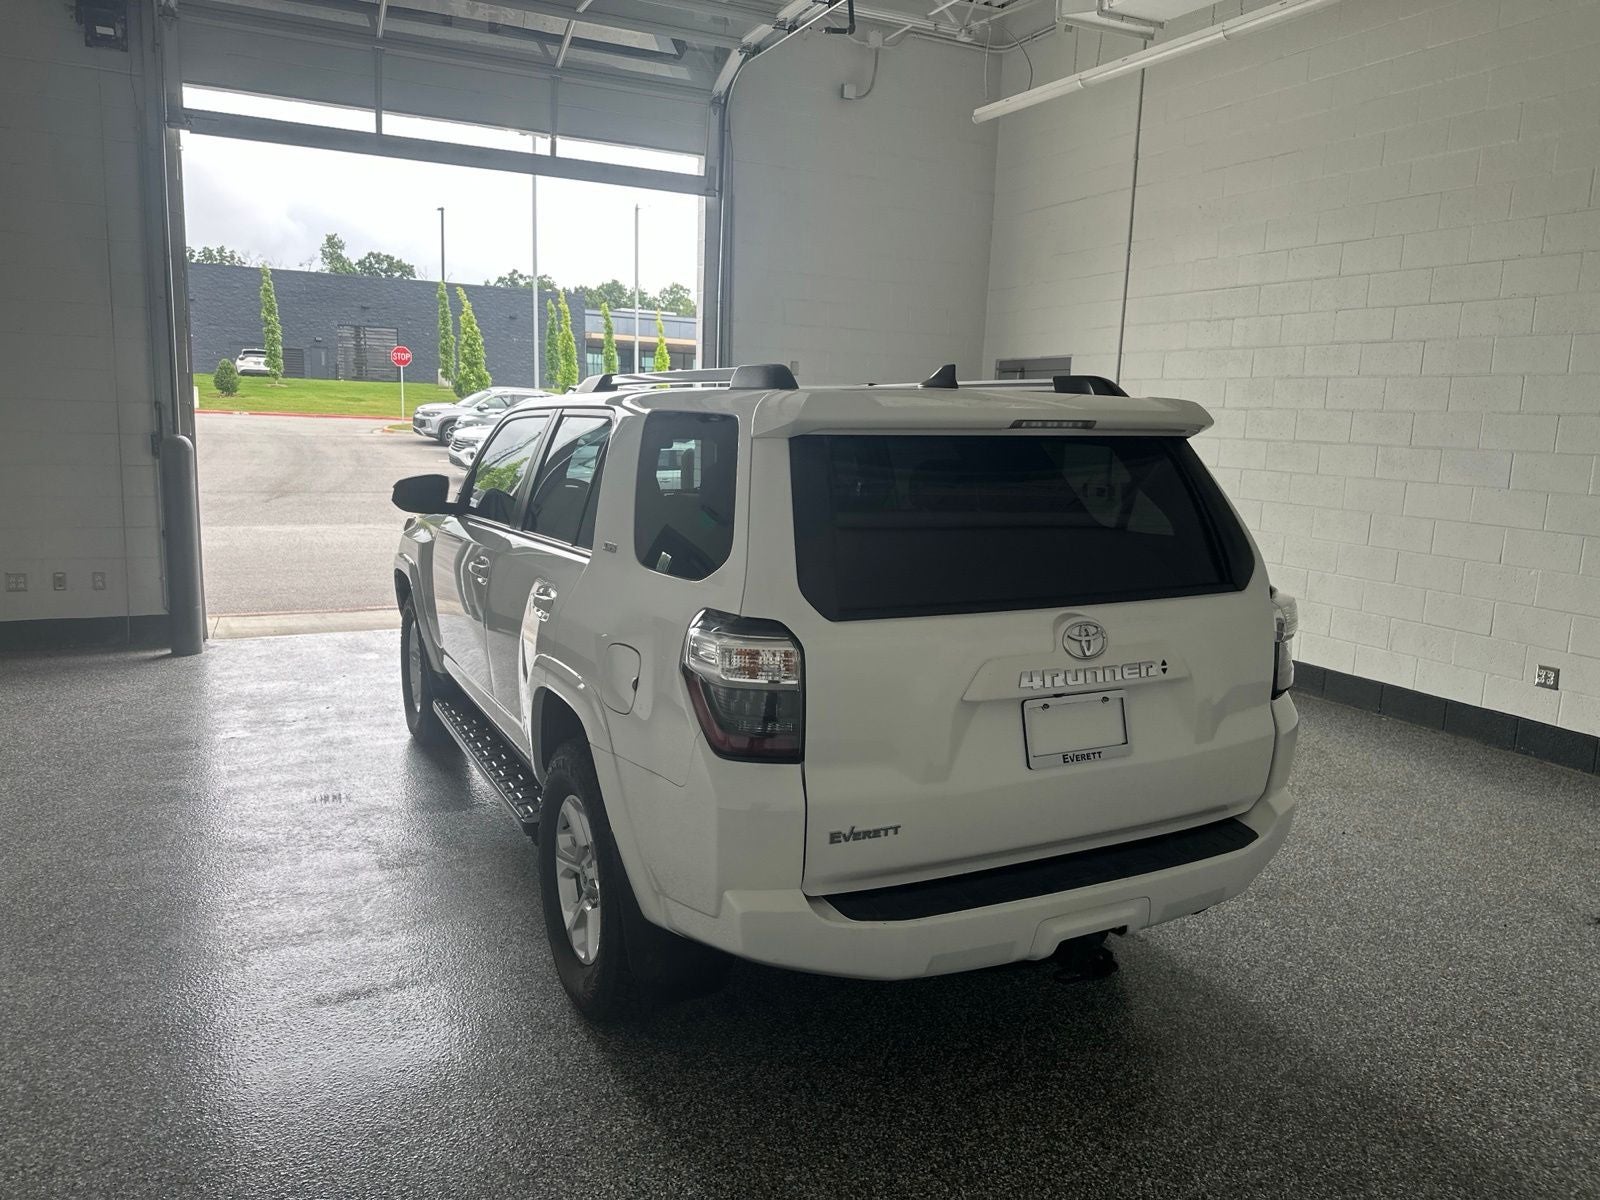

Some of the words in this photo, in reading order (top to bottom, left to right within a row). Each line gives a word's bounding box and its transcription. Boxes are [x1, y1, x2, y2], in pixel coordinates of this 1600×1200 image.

[392, 352, 411, 361] STOP
[1062, 751, 1103, 764] EVERETT
[828, 825, 902, 845] EVERETT
